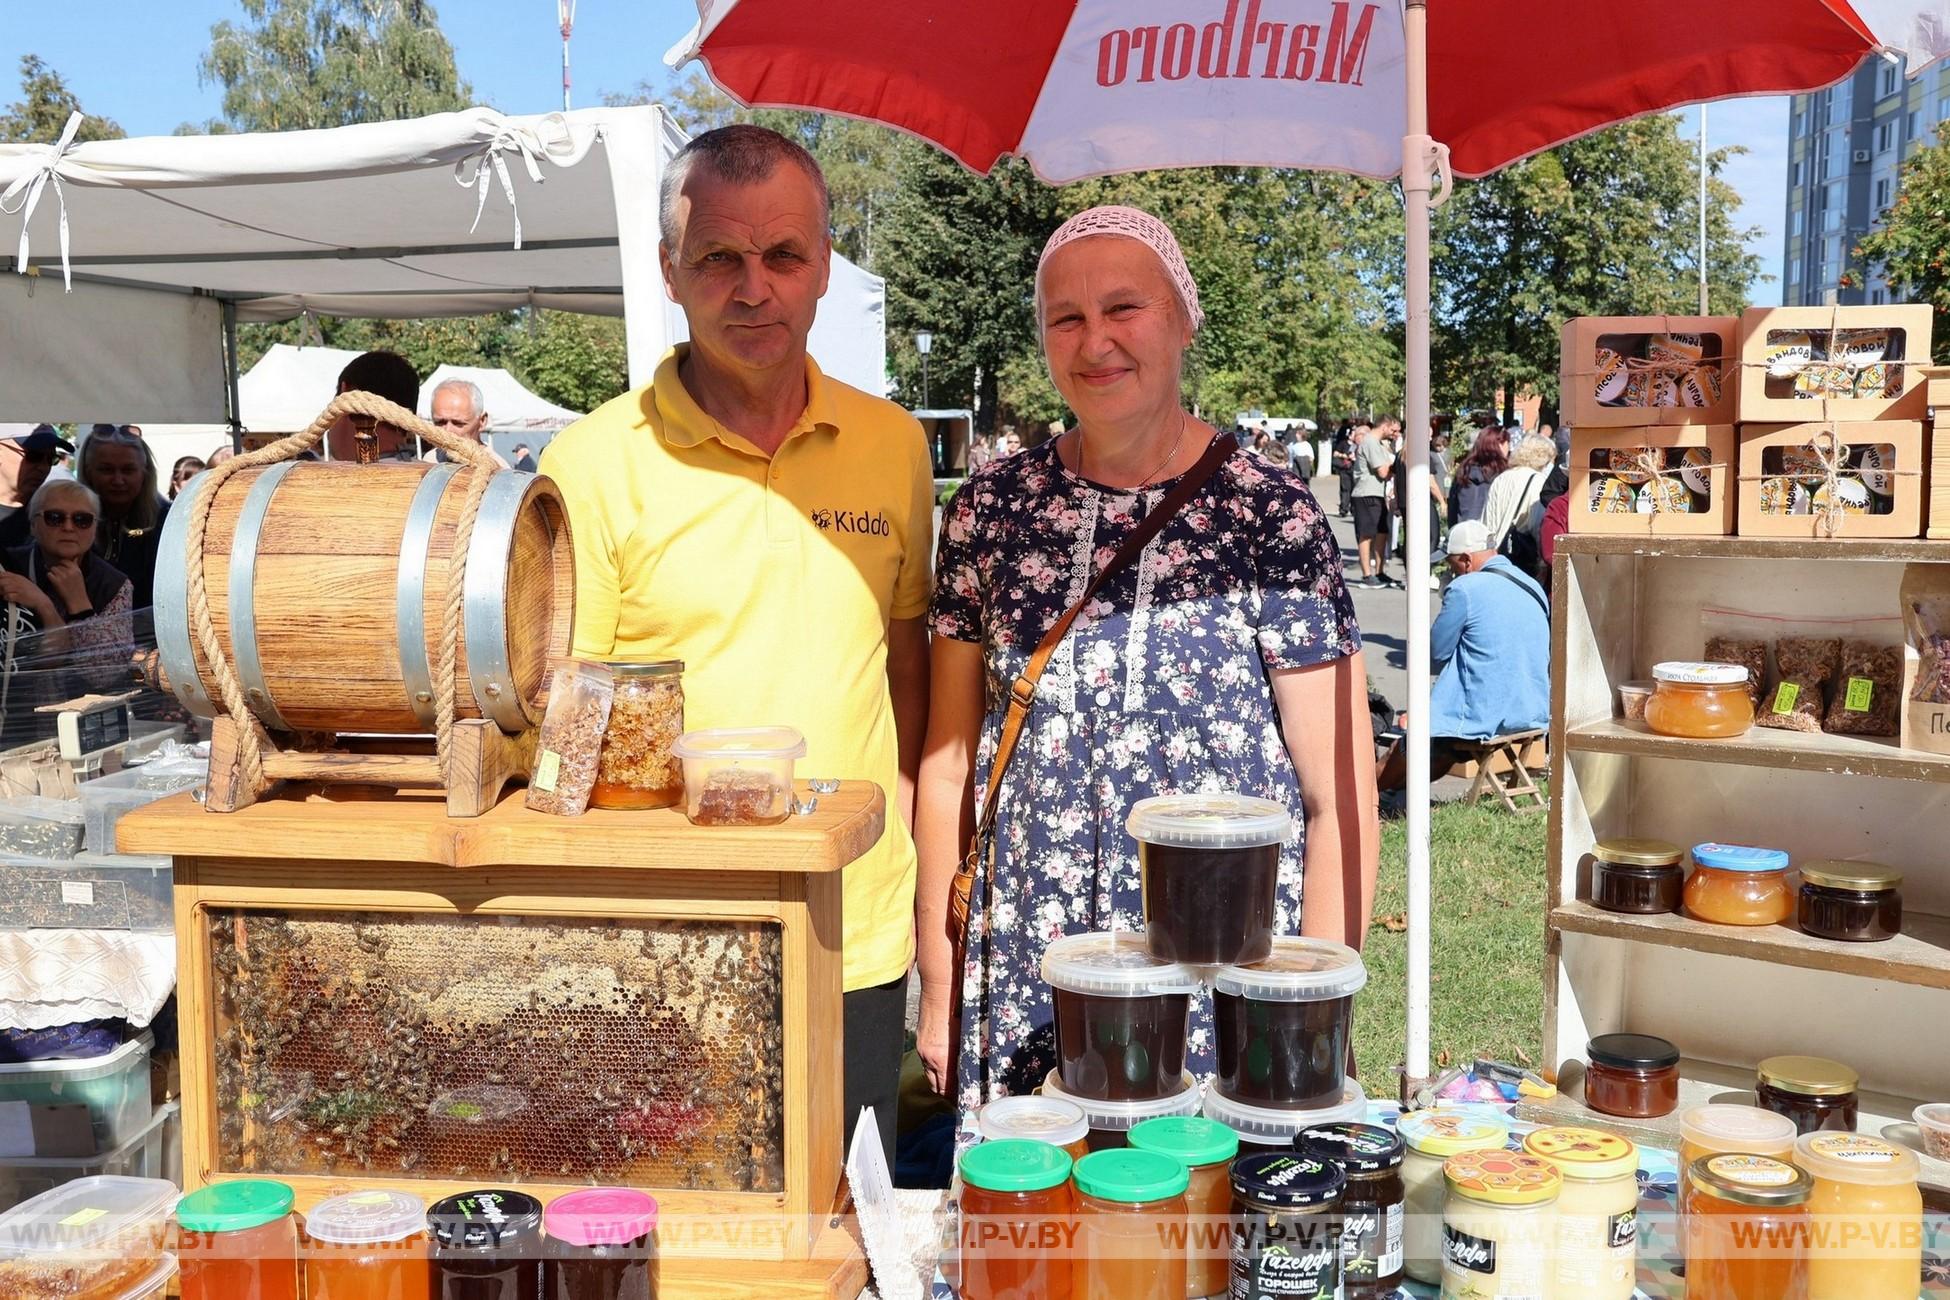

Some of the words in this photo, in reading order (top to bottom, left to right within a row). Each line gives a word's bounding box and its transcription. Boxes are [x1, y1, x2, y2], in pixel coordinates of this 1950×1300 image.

[834, 510, 890, 537] Kiddo
[1260, 1248, 1333, 1271] Fazenda
[1258, 1277, 1318, 1290] ГОРОШЕК
